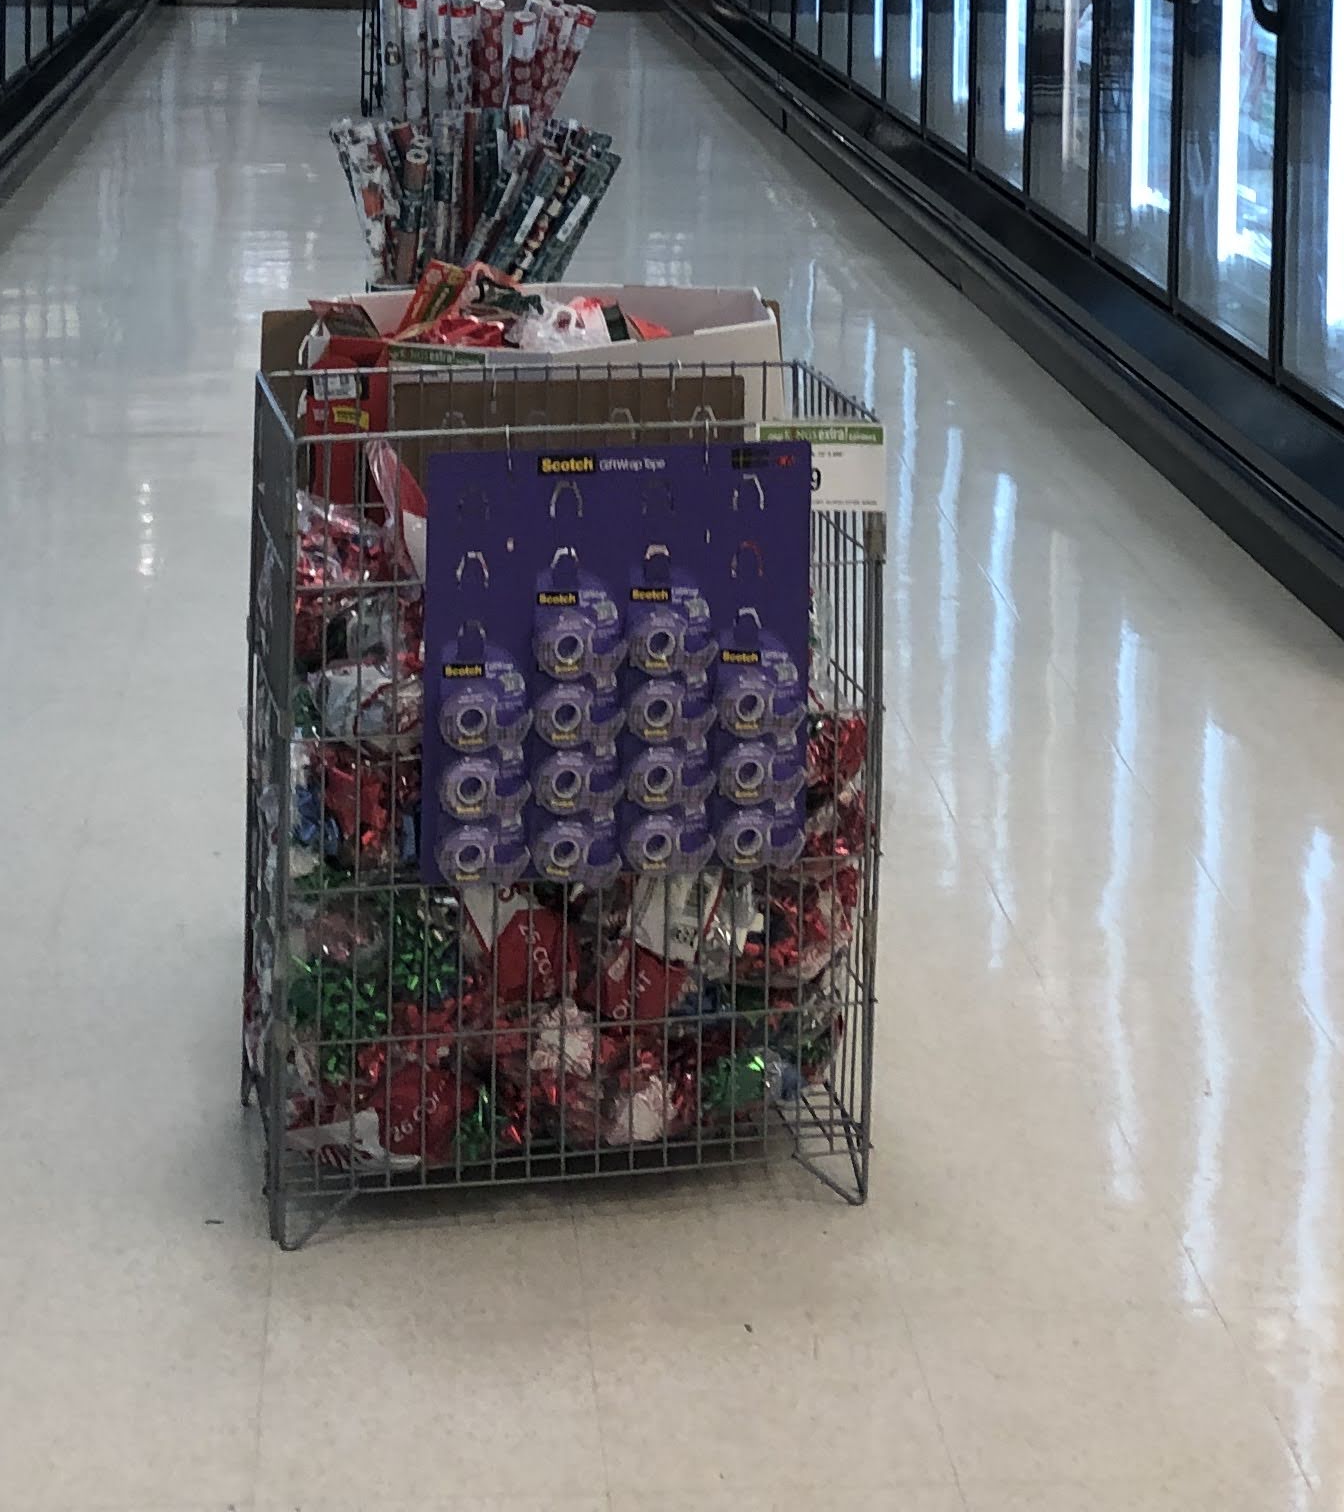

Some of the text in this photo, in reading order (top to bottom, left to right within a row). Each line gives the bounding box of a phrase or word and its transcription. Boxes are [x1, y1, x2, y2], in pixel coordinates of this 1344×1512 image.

[541, 457, 594, 473] Scotch
[539, 593, 576, 605] Scotch
[634, 589, 669, 600] Scotch
[722, 650, 759, 662] Scotch
[444, 664, 482, 676] Scotch
